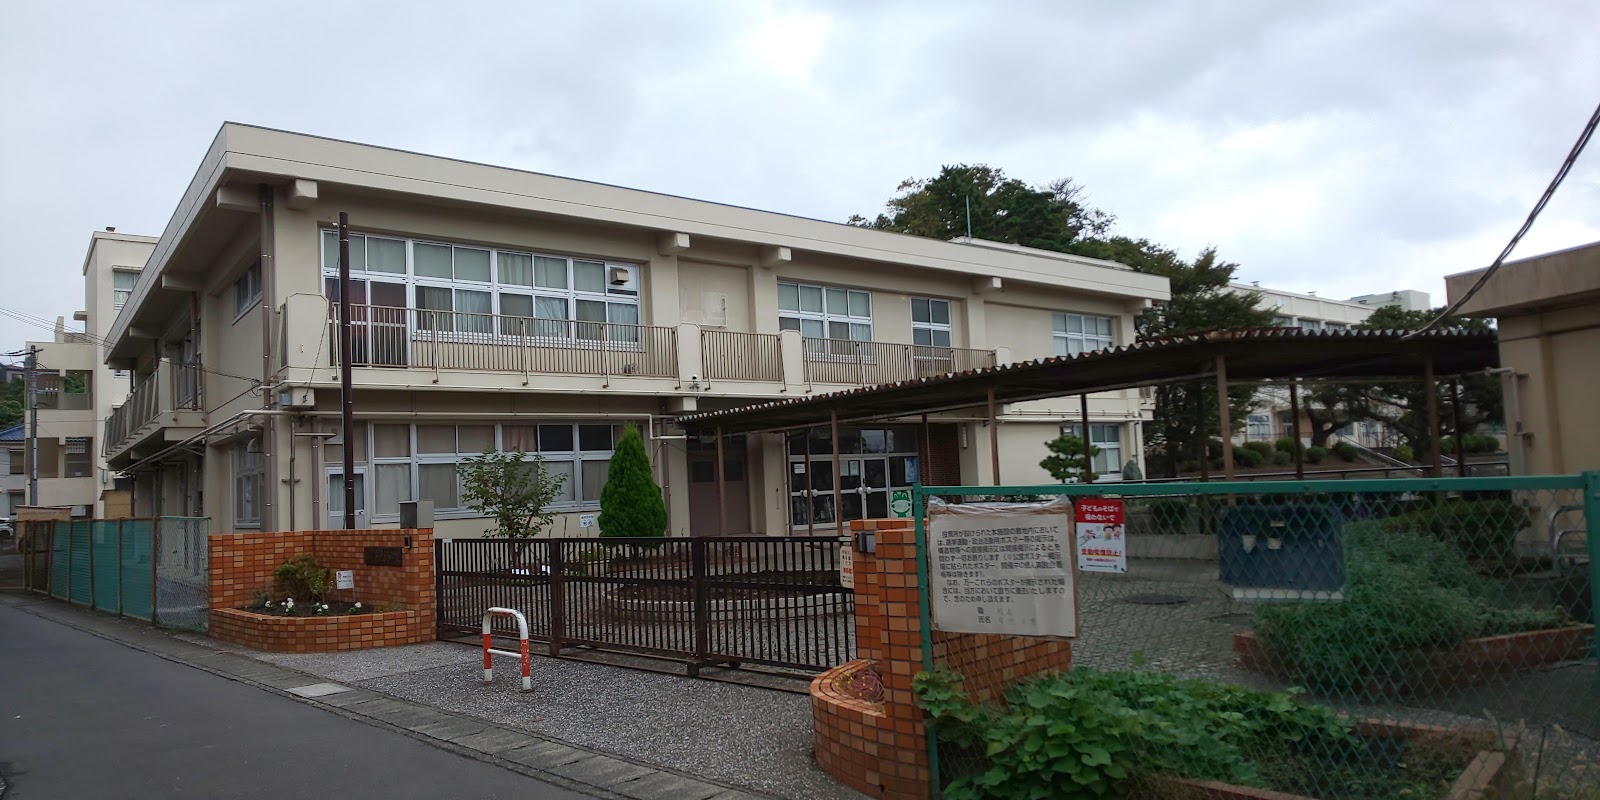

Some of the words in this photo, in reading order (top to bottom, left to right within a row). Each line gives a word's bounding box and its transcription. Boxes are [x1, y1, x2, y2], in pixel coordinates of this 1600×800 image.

[1081, 504, 1119, 512] 子どものそばで
[1084, 513, 1115, 521] 吸わないで
